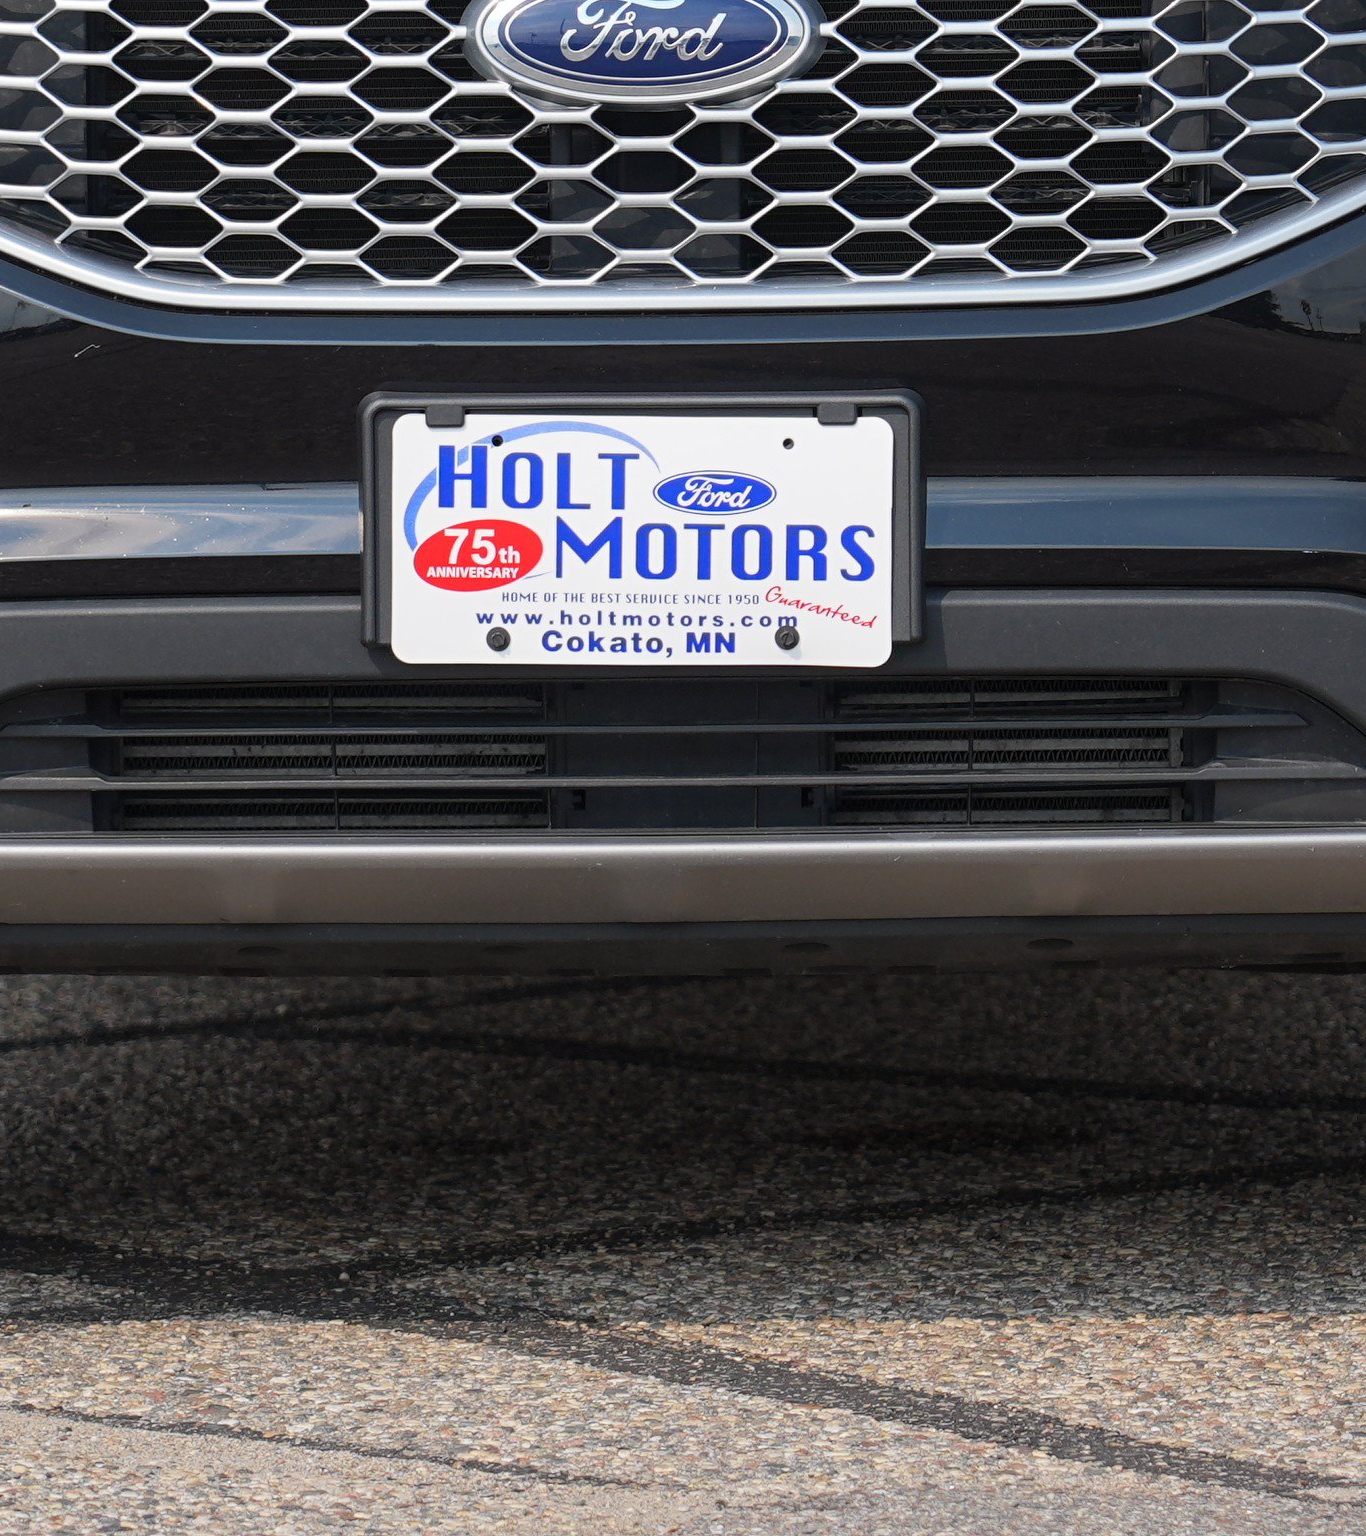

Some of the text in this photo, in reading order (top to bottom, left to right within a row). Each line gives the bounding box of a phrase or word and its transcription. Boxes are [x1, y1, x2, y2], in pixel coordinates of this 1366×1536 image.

[438, 444, 640, 511] HOLT
[676, 476, 753, 508] Ford
[443, 528, 521, 566] 75th
[555, 516, 875, 582] MOTORS
[426, 566, 520, 579] ANNIVERSARY
[501, 591, 760, 605] HOME OF THE BEST SERVICE SINCE 1950
[765, 585, 878, 629] Guaranteed
[476, 609, 798, 628] www.holtmotors.com
[541, 630, 736, 658] Cokato, MN
